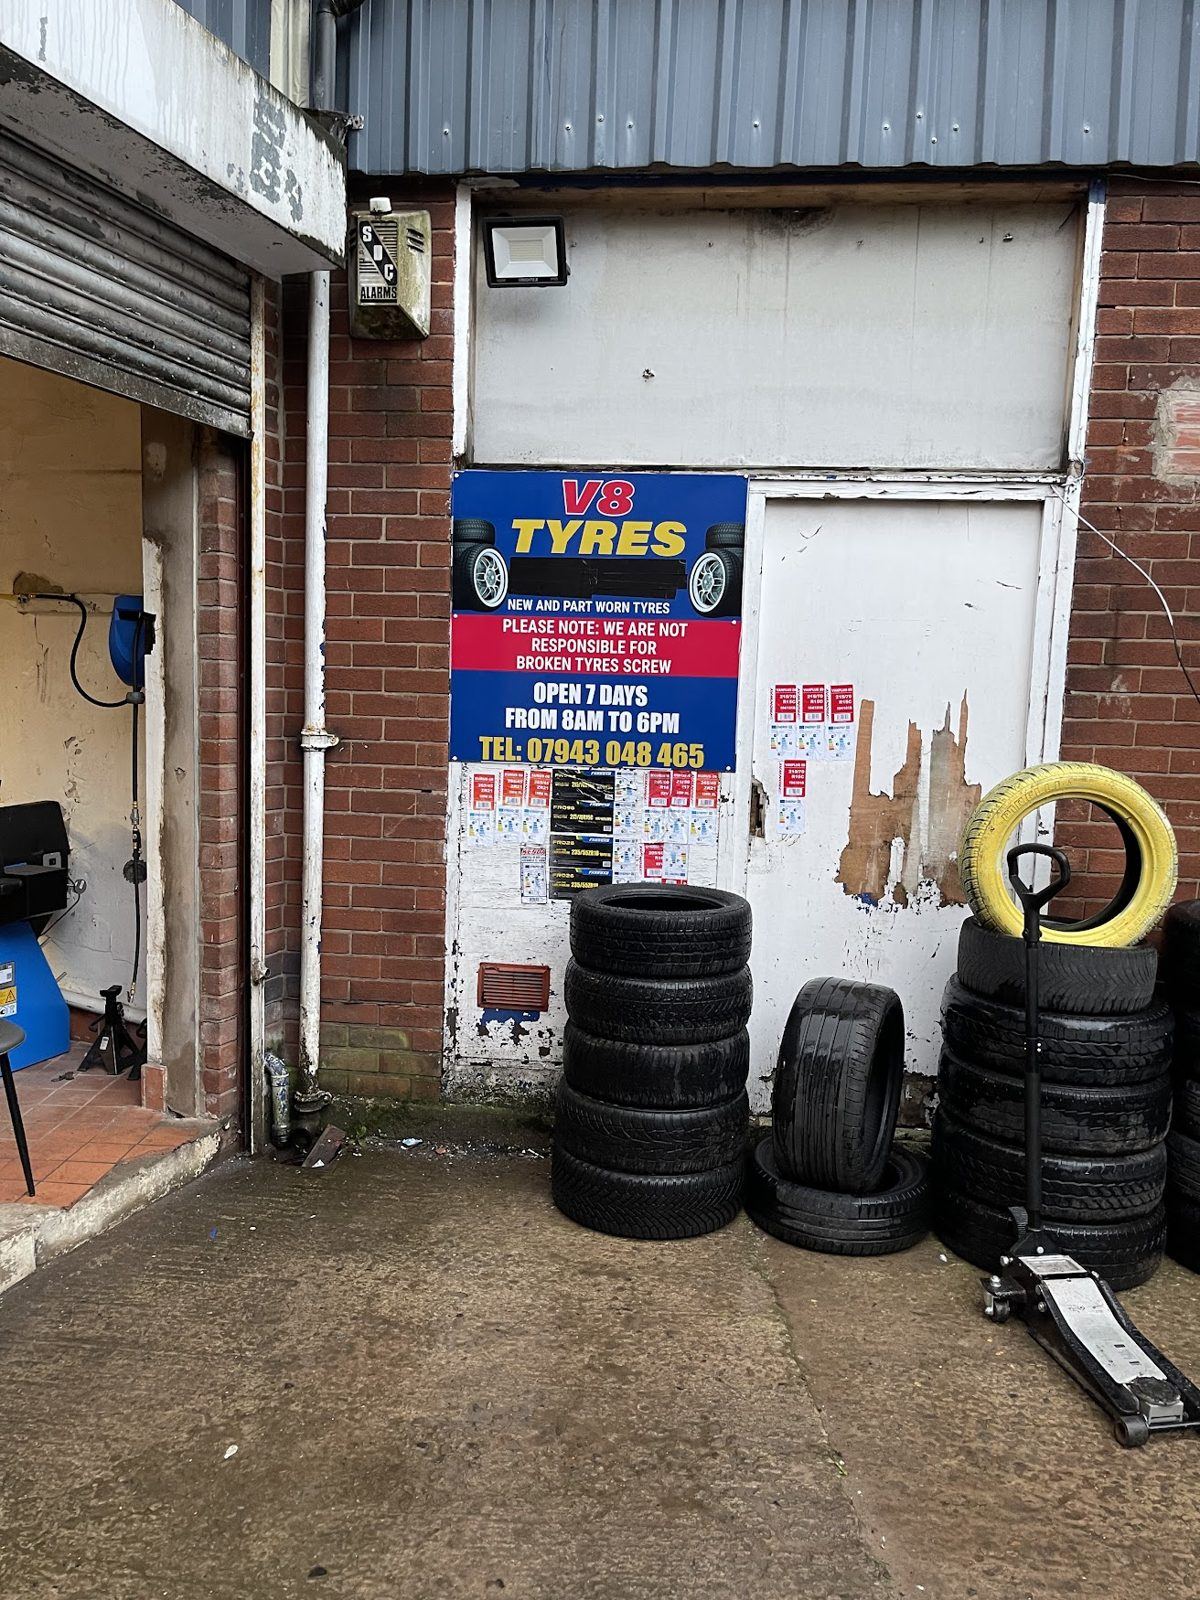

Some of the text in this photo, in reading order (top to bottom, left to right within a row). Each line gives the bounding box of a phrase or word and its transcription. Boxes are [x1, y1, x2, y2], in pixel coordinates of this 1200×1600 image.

[360, 286, 398, 299] ALARMS
[562, 479, 635, 517] V8
[511, 519, 687, 557] TYRES
[507, 599, 670, 614] NEW AND PART WORN TYRES
[502, 618, 688, 638] PLEASE NOTE: WE ARE NOT
[531, 637, 657, 655] RESPONSIBLE FOR
[516, 656, 671, 674] BROKEN TYRES SCREW
[533, 682, 648, 707] OPEN 7 DAYS
[505, 707, 680, 734] FROM 8AM TO 6PM
[478, 735, 705, 769] TEL: 07943 048 465
